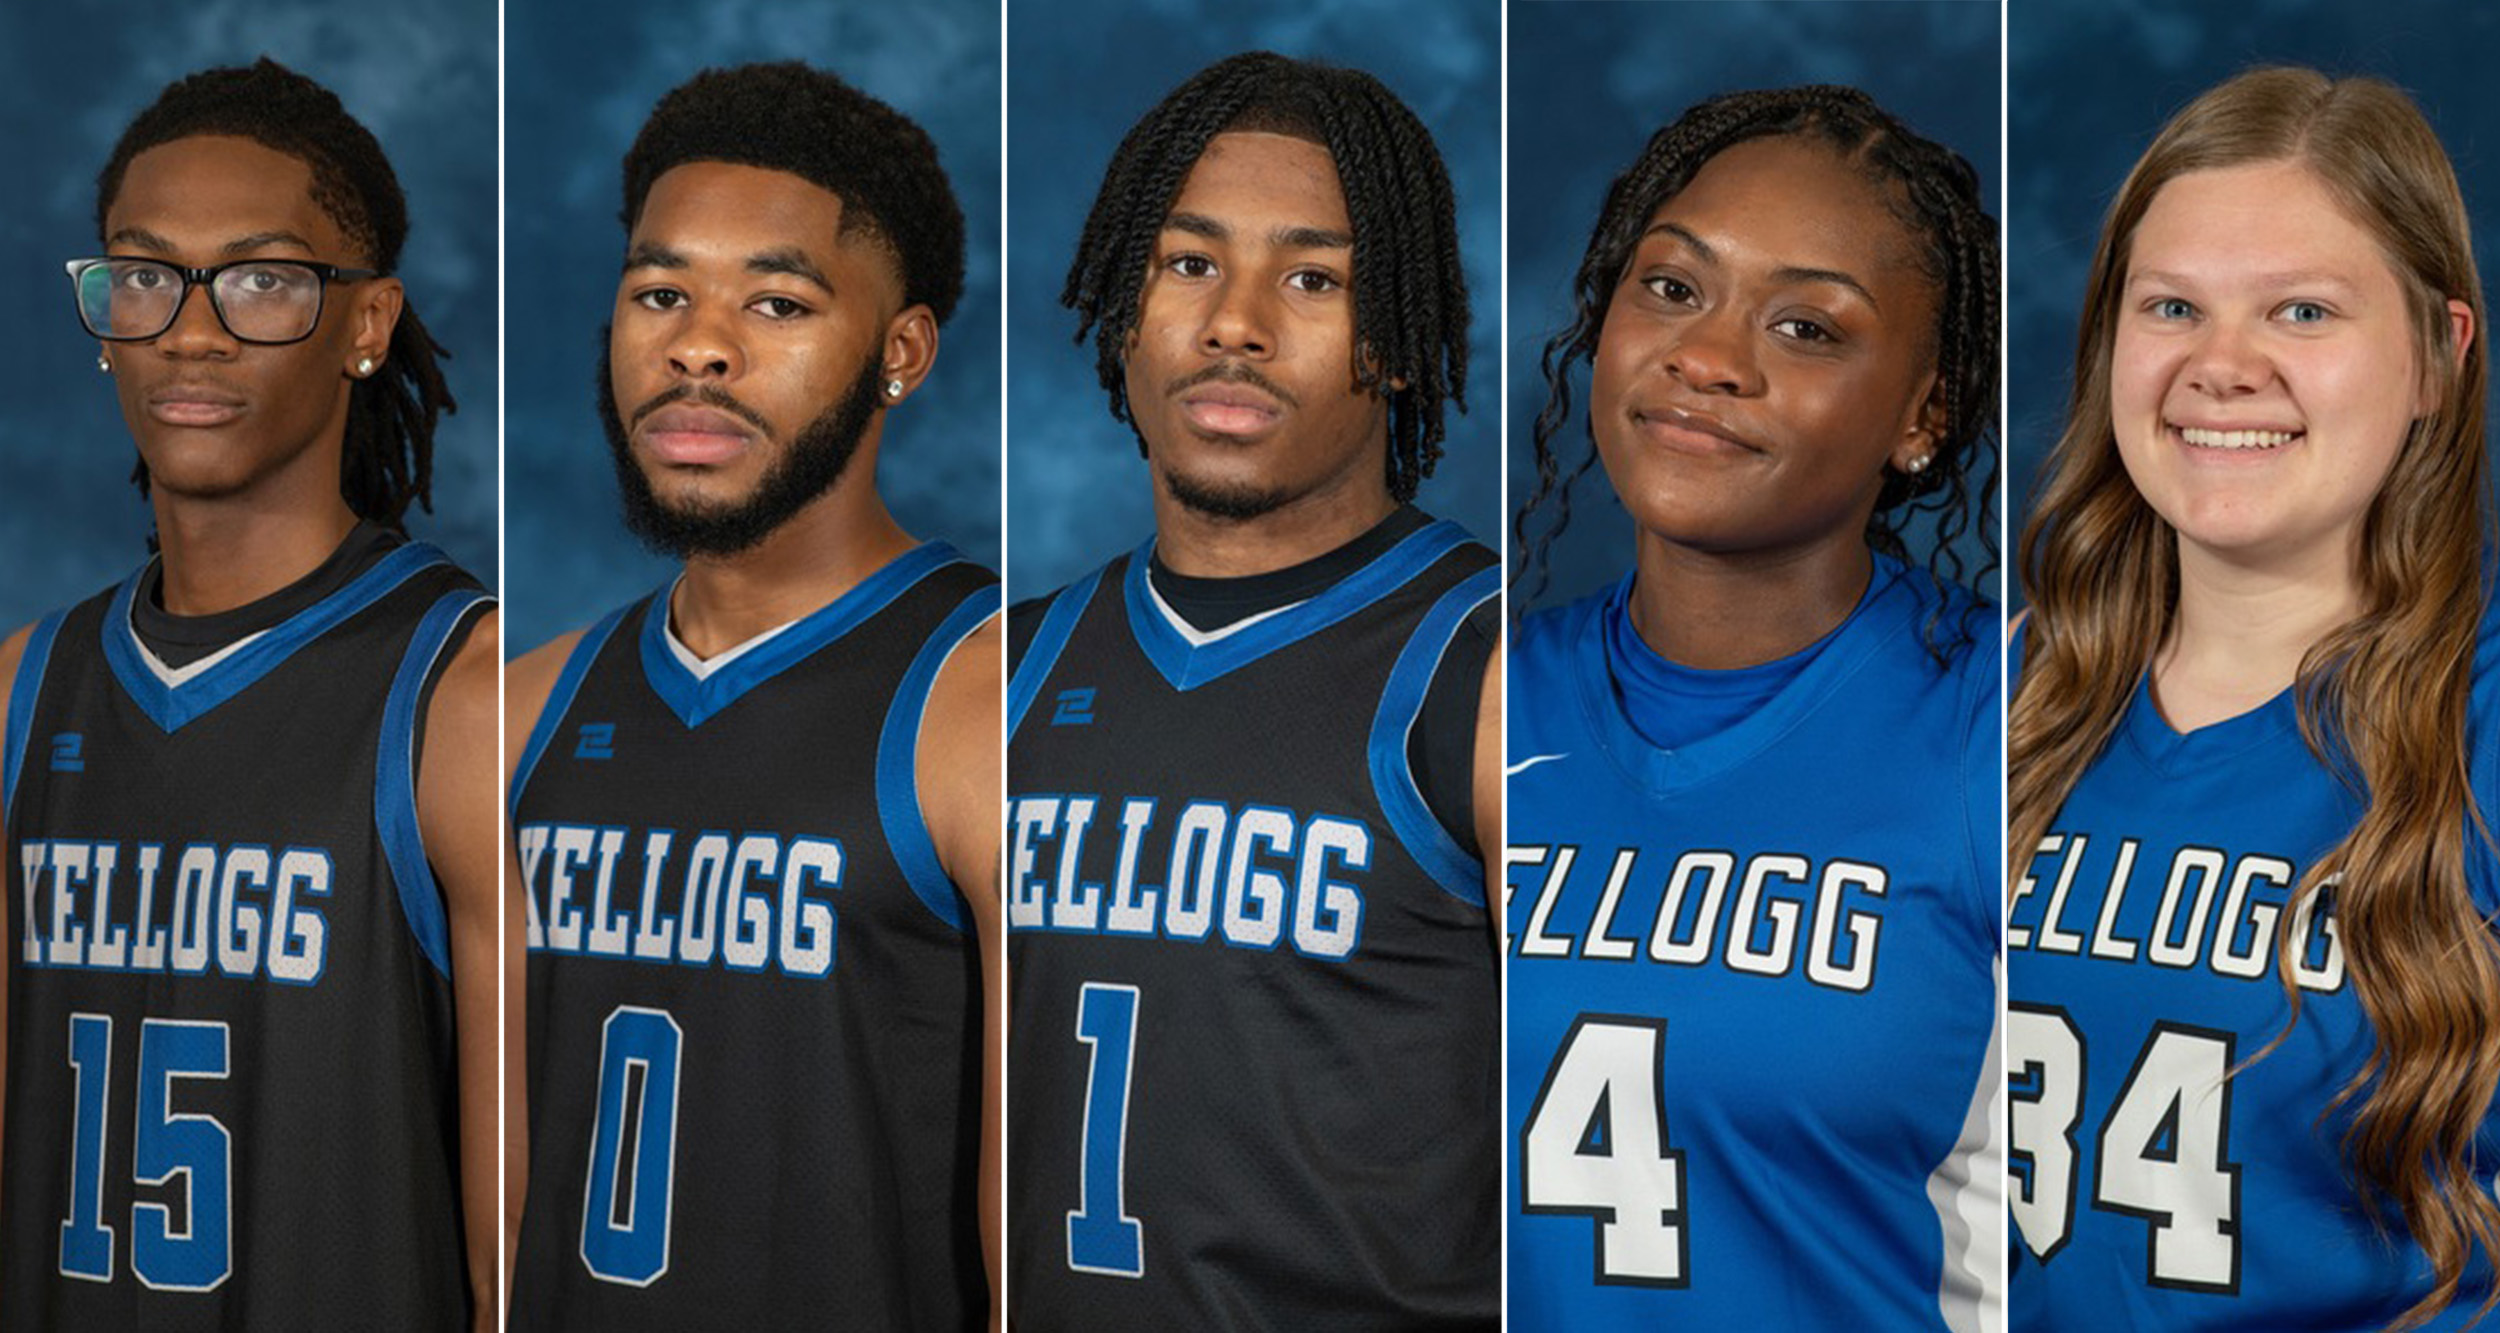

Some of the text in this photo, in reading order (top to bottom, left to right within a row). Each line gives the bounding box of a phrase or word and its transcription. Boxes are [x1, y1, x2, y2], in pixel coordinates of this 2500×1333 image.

[21, 838, 334, 986] KELLOGG
[519, 820, 845, 979] KELLOGG
[1007, 793, 1374, 963] ELLOGG
[59, 1013, 233, 1292] 15
[579, 1004, 683, 1288] 0
[1066, 982, 1144, 1278] 1
[1520, 1011, 1690, 1290] 4
[2008, 1000, 2242, 1296] 34
